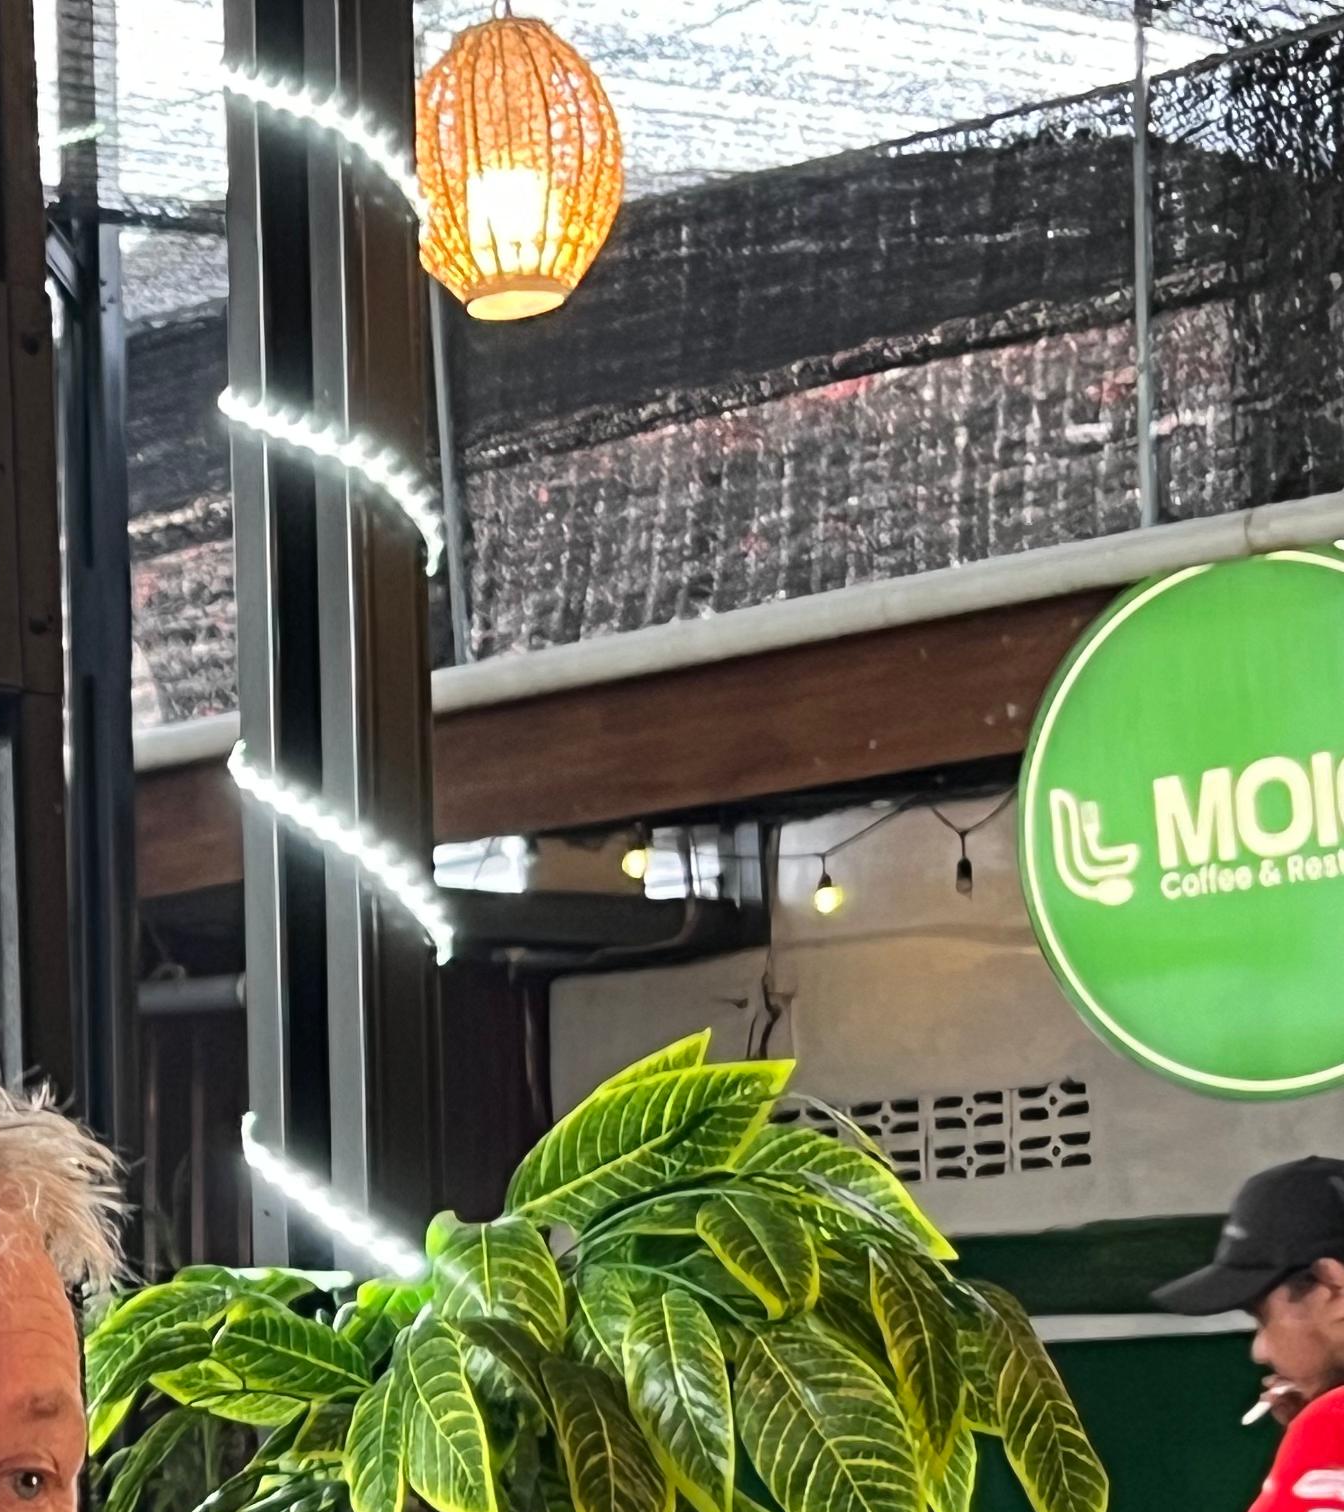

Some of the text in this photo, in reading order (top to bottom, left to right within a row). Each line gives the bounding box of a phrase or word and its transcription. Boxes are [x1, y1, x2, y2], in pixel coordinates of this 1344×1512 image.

[1153, 751, 1344, 870] MOI
[1160, 863, 1252, 900] Coffee
[1259, 858, 1282, 888] &
